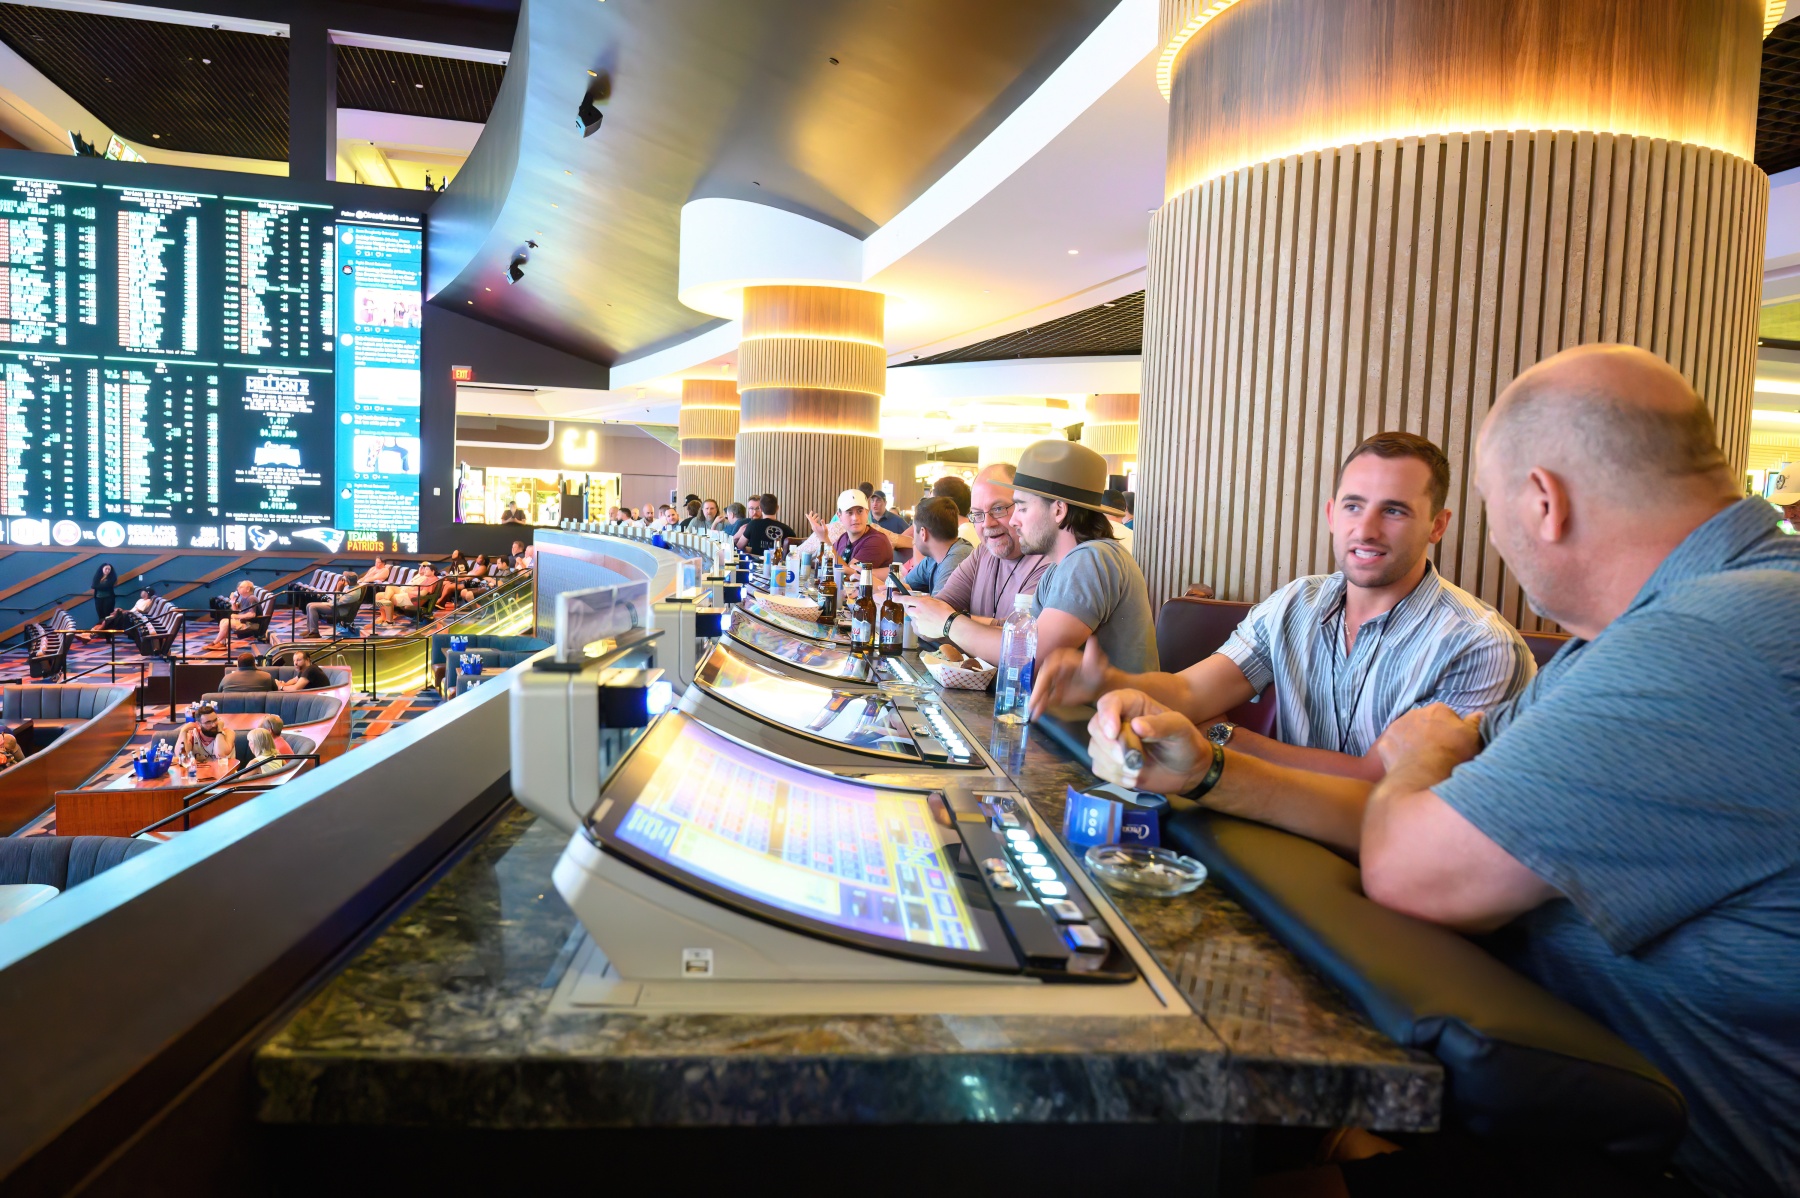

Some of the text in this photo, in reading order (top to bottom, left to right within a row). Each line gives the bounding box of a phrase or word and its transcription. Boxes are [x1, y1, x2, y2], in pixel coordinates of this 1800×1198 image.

[455, 369, 469, 379] EXIT
[246, 378, 298, 393] MILLION
[348, 531, 398, 542] TEXANS 7
[347, 541, 384, 552] PATRIOTS
[392, 542, 398, 552] 3
